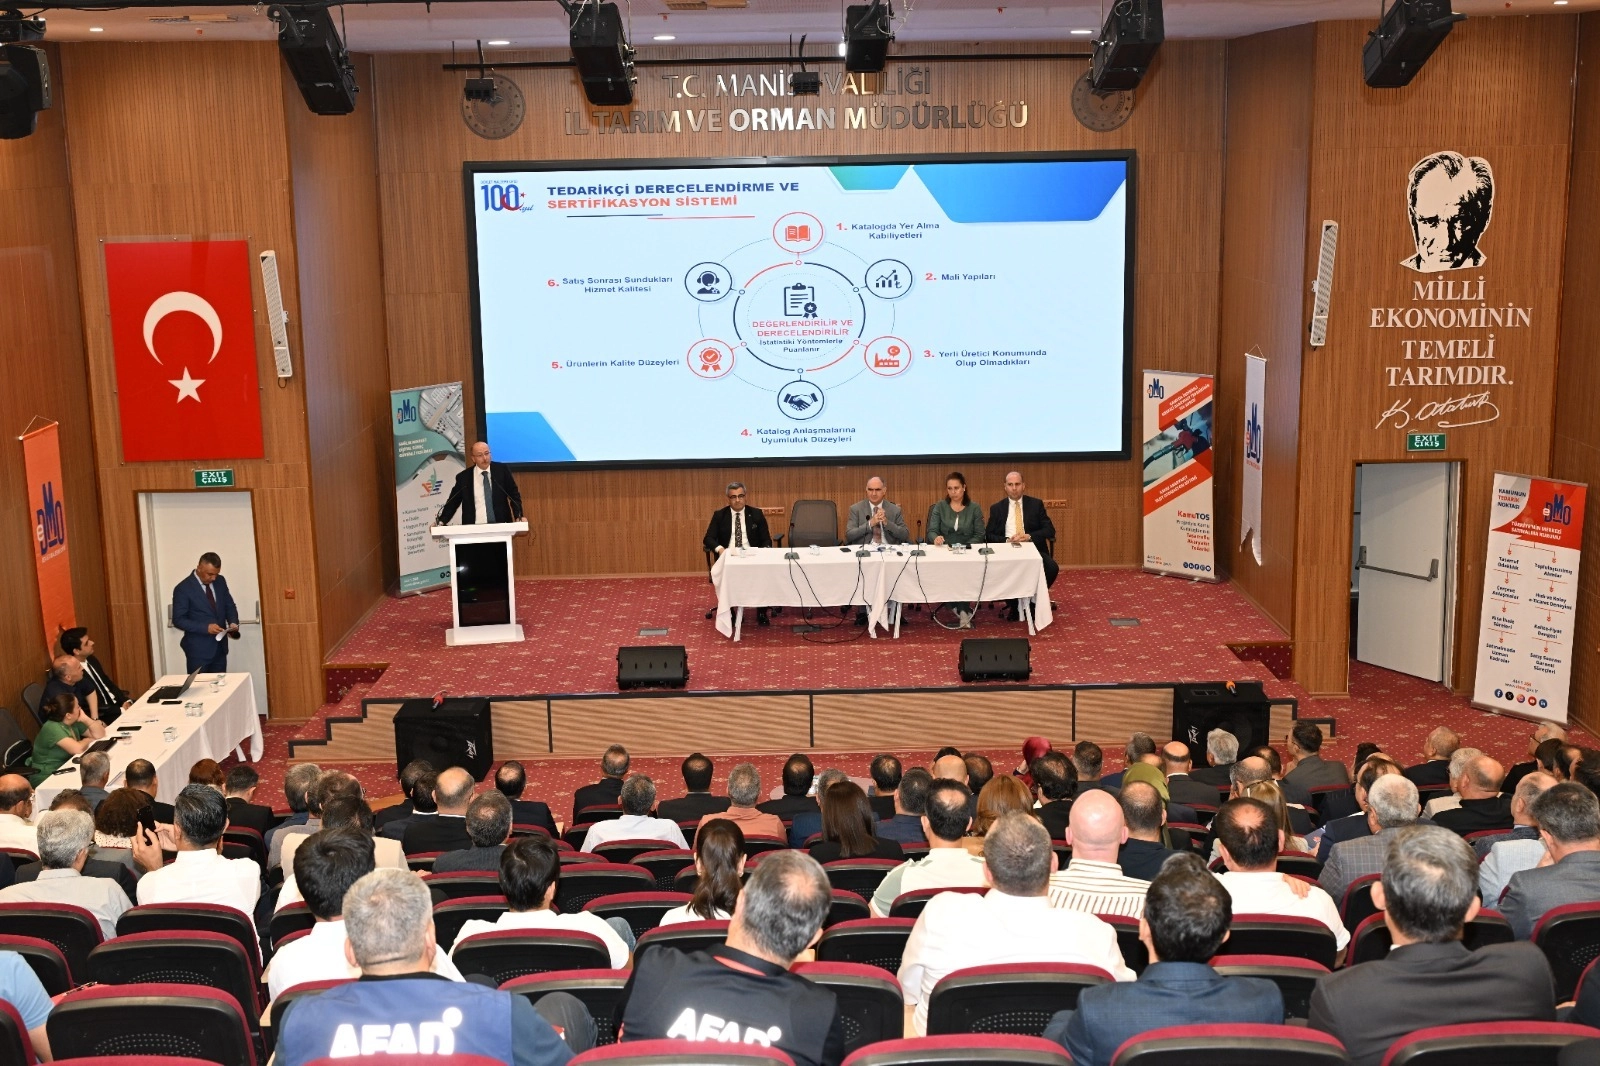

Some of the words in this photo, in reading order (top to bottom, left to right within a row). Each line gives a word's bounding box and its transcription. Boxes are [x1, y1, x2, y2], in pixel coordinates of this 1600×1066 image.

[662, 74, 707, 99] T.C.
[565, 107, 589, 136] İL
[592, 109, 682, 135] TARIM
[686, 109, 723, 133] VE
[729, 106, 836, 132] ORMAN
[843, 100, 1029, 131] MÜDÜRLÜĞÜ
[547, 183, 630, 197] TEDARİKÇİ
[635, 181, 775, 194] DERECELENDİRME
[779, 182, 800, 192] VE
[547, 197, 671, 209] SERTİFİKASYON
[675, 194, 738, 207] SİSTEMİ
[836, 223, 848, 231] 1.
[851, 223, 897, 232] Katalogda
[899, 222, 914, 230] Yer
[916, 222, 940, 230] Alma
[869, 231, 923, 240] Kabiliyetleri
[547, 279, 560, 287] 6.
[562, 277, 585, 285] Satış
[624, 276, 673, 284] Sundukları
[925, 272, 937, 281] 2.
[941, 273, 960, 281] Mali
[962, 273, 996, 282] Yapıları
[1412, 275, 1487, 301] MİLLİ
[1369, 302, 1533, 328] EKONOMİNİN
[752, 318, 838, 328] DEĞERLENDİRİLİR
[841, 319, 853, 327] VE
[757, 328, 850, 337] DERECELENDİRİLİR
[1401, 333, 1496, 360] TEMELİ
[924, 349, 935, 358] 3.
[938, 350, 959, 358] Yerli
[961, 350, 990, 358] Üretici
[992, 349, 1047, 357] Konumunda
[551, 361, 563, 369] 5.
[566, 360, 607, 368] Ürünlerin
[610, 359, 635, 367] Kalite
[638, 359, 680, 367] Düzeyleri
[955, 359, 977, 367] Olup
[979, 358, 1030, 366] Olmadıkları
[1385, 365, 1514, 387] TARIMDIR.
[740, 428, 753, 437] 4.
[756, 427, 791, 436] Katalog
[793, 427, 856, 436] Anlaşmalarına
[761, 436, 808, 445] Uyumluluk
[811, 435, 852, 444] Düzeyleri
